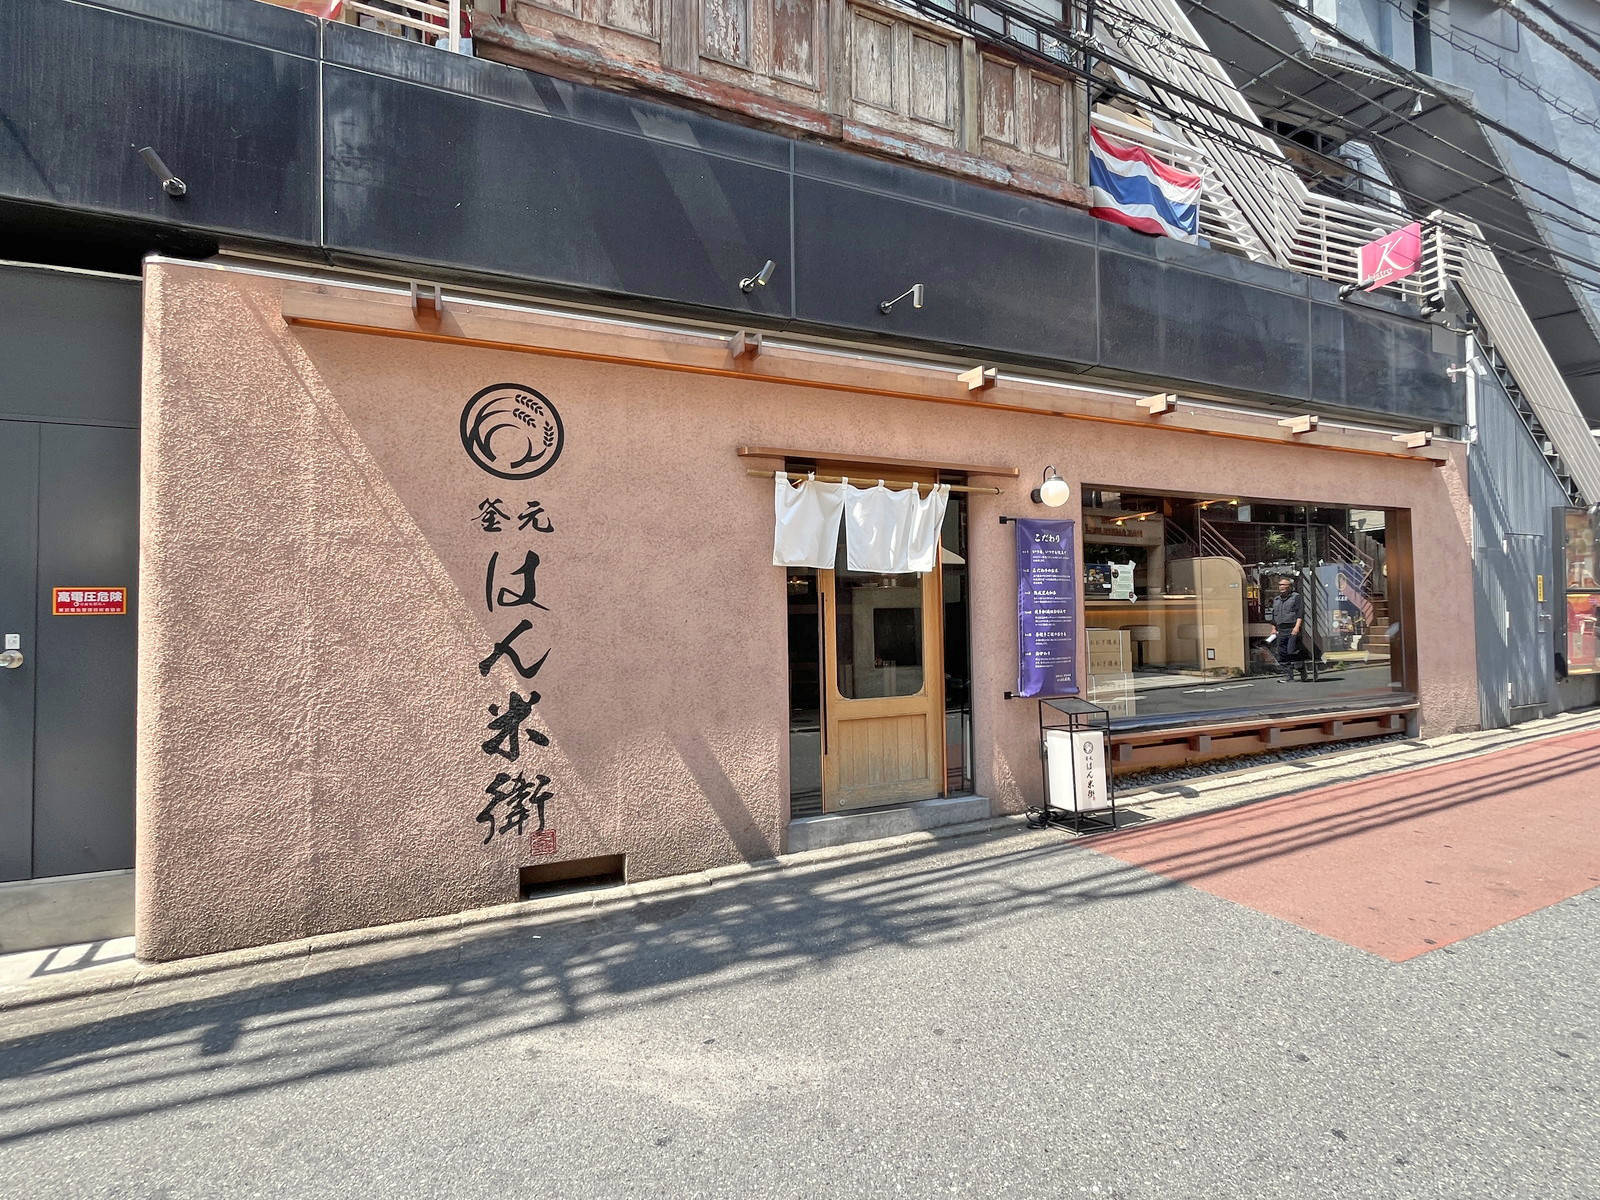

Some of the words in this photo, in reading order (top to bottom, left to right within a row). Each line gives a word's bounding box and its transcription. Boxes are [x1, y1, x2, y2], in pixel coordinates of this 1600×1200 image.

[1376, 236, 1416, 273] K
[471, 497, 555, 534] 釜元
[1034, 533, 1060, 543] こだわり
[57, 591, 123, 603] 高電圧危険
